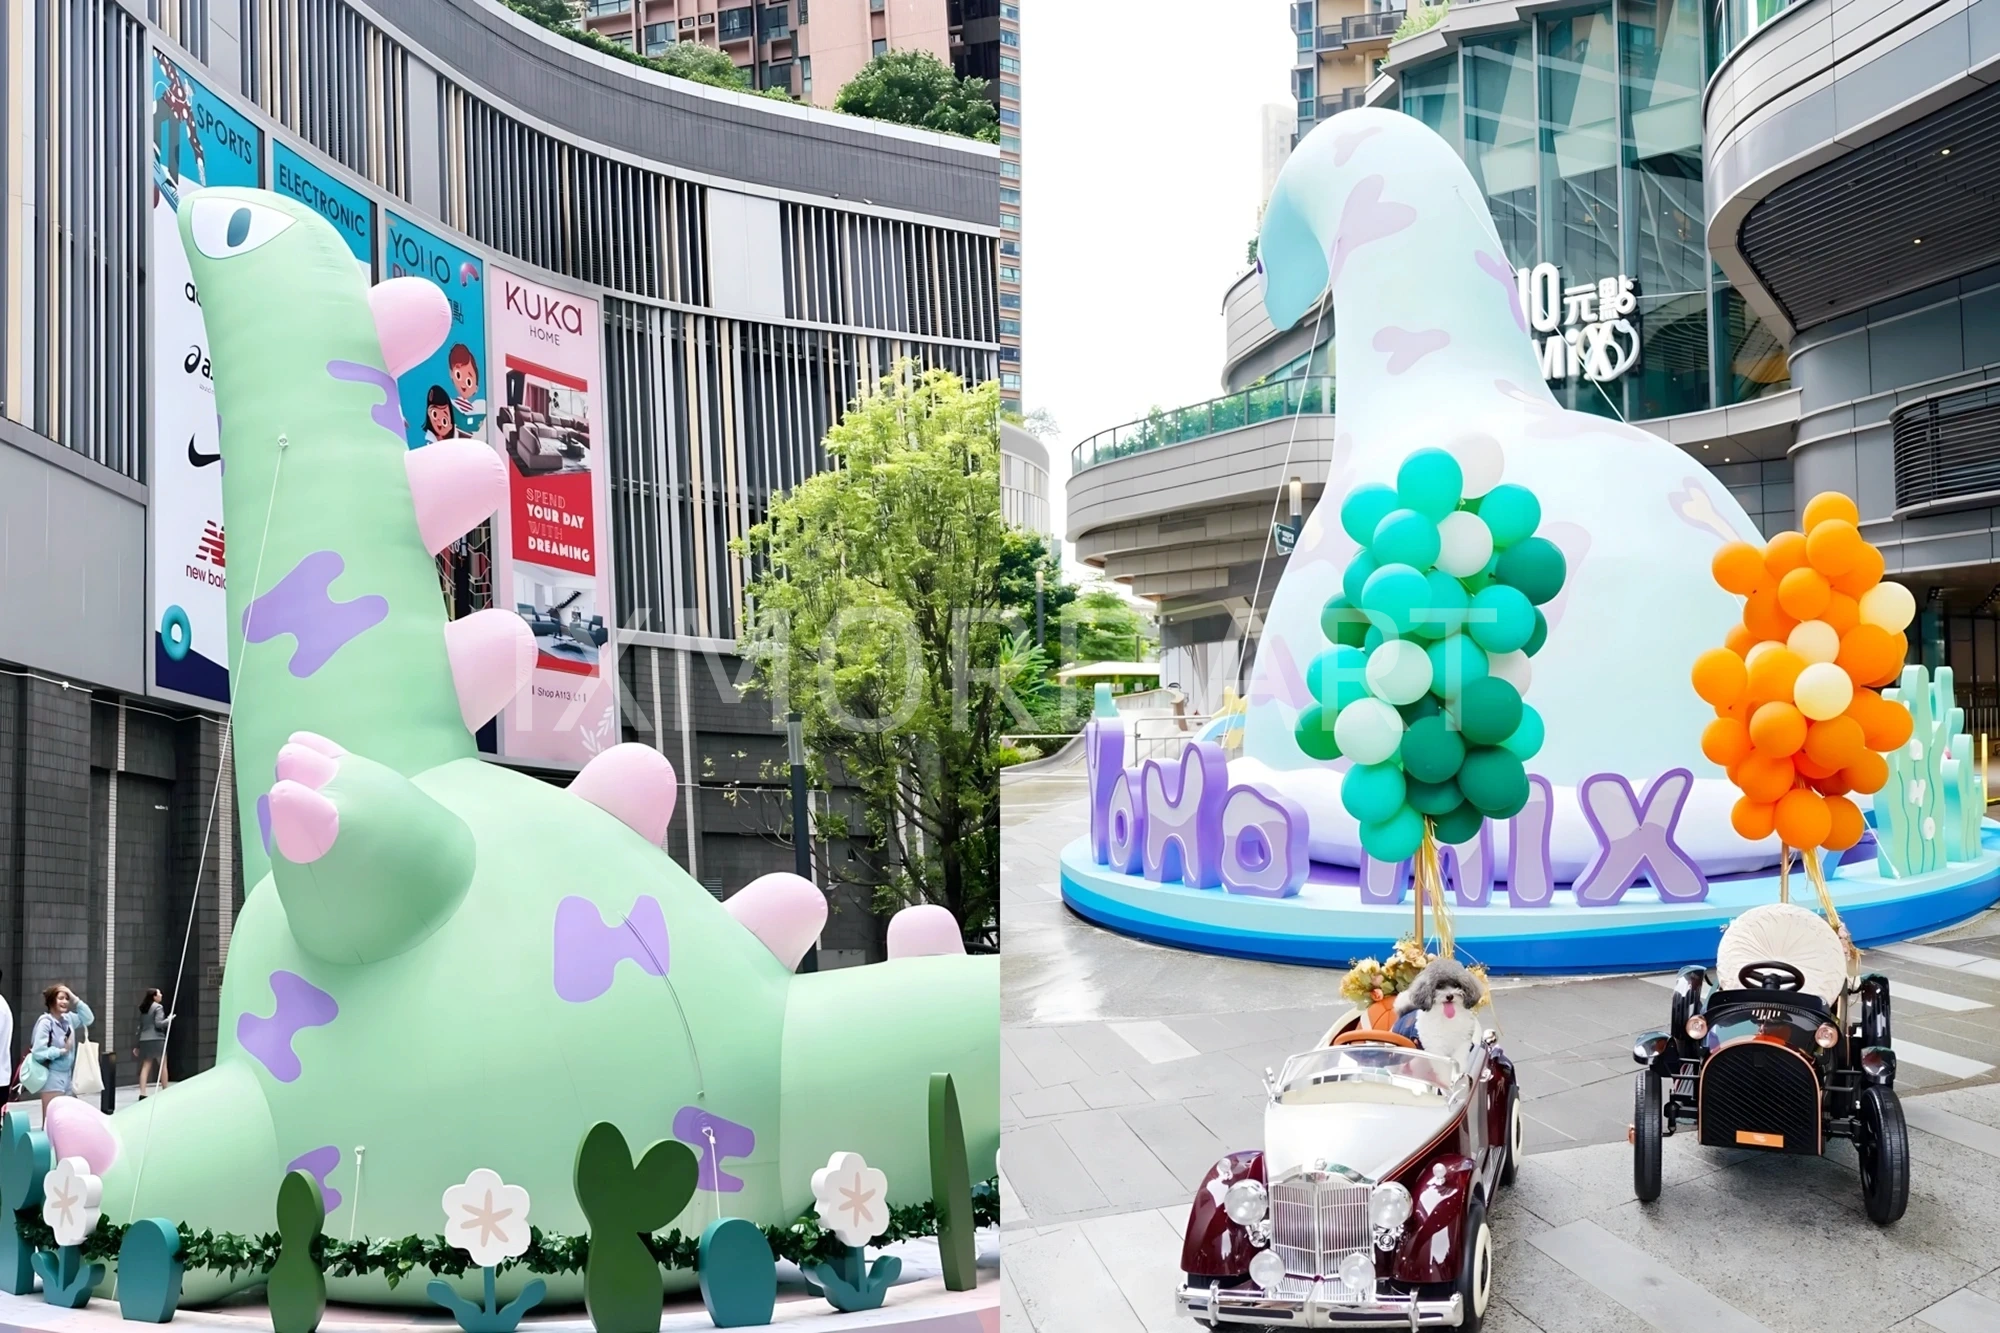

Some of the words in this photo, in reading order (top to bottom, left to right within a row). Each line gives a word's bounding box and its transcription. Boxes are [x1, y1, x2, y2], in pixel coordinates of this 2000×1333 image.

[197, 103, 252, 165] SPORTS
[280, 163, 365, 237] ELECTRONIC
[529, 325, 560, 346] HOME
[526, 488, 566, 509] SPEND
[526, 503, 560, 523] YOUR
[562, 512, 585, 529] DAY
[528, 520, 563, 541] WITH
[528, 535, 590, 562] DREAMING
[186, 564, 206, 582] new
[537, 687, 554, 699] Shop
